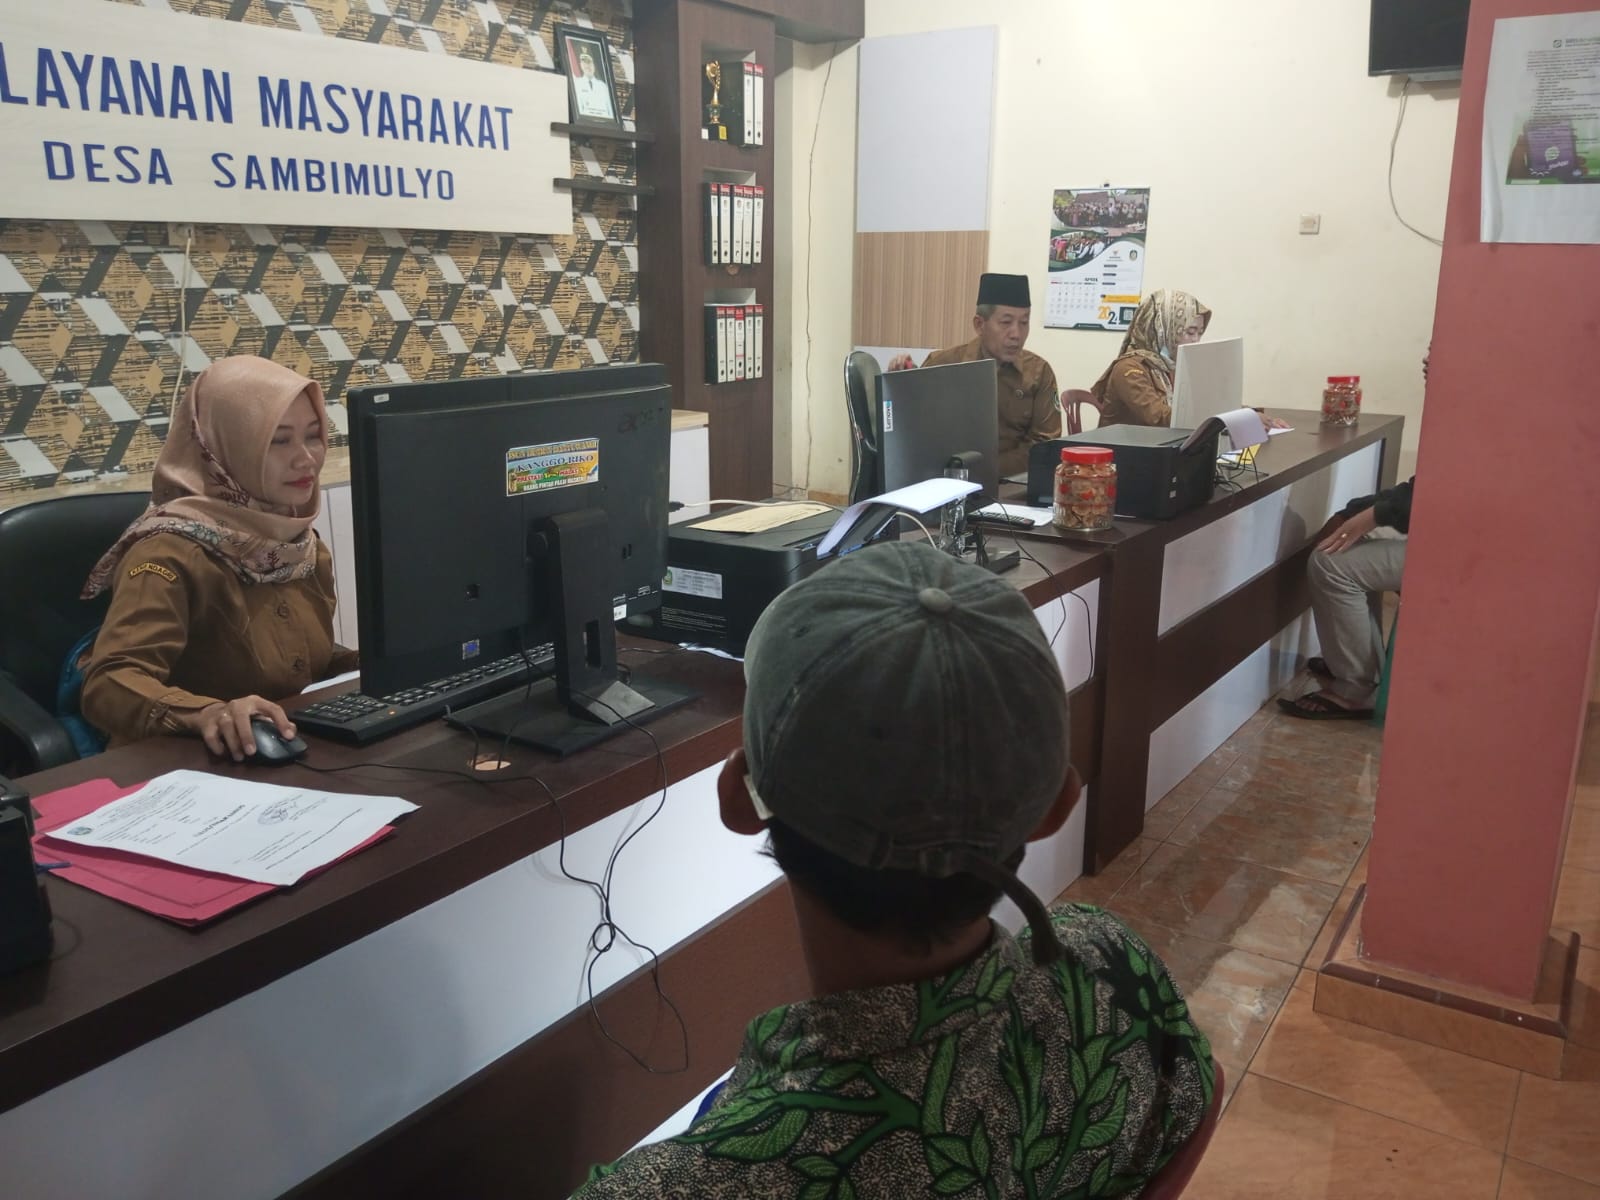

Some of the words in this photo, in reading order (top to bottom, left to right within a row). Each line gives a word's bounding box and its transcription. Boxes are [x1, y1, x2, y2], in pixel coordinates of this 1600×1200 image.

[0, 42, 233, 124] LAYANAN
[258, 76, 513, 151] MASYARAKAT
[43, 141, 173, 185] DESA
[211, 152, 454, 200] SAMBIMULYO
[517, 457, 565, 472] KANGGO
[569, 455, 594, 463] RIKO
